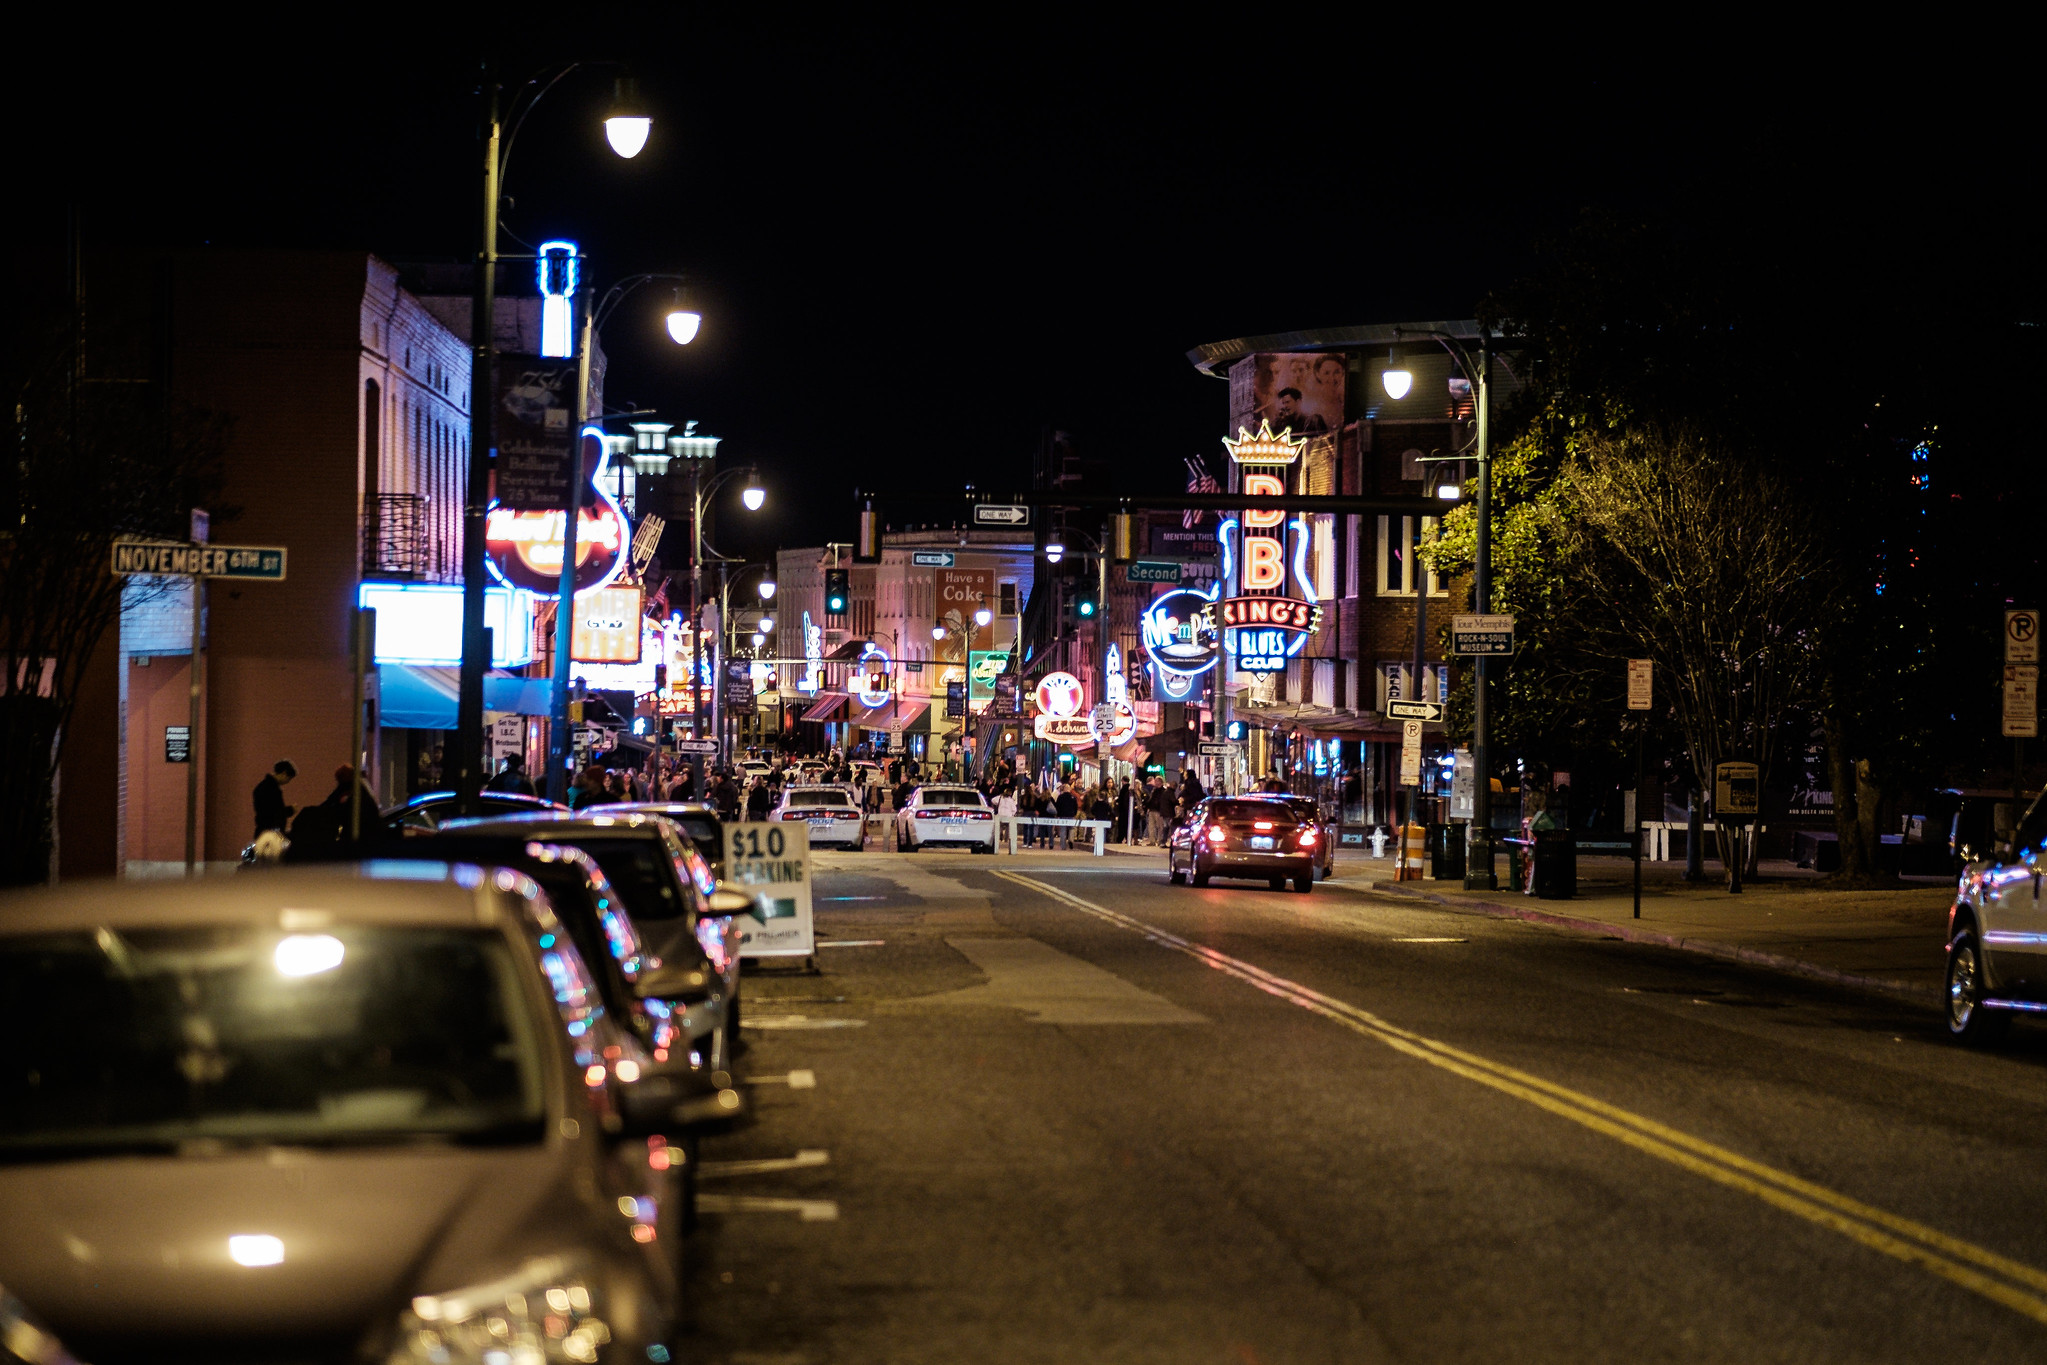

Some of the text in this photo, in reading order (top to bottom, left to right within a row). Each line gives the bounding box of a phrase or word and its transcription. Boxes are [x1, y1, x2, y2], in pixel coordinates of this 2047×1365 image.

[499, 439, 570, 460] Celebrating
[508, 455, 560, 471] Brilliant
[500, 472, 568, 487] Service for
[507, 487, 561, 502] 75 Years
[981, 511, 1013, 519] ONE WAY
[1163, 532, 1215, 541] MENTION THIS
[1192, 542, 1216, 552] FREE
[117, 546, 280, 575] NOVEMBER 6TH ST
[945, 572, 984, 583] Have a
[1131, 564, 1178, 581] Second
[943, 585, 984, 602] Coke
[1224, 601, 1308, 627] KING'S
[1457, 618, 1511, 631] Tour Memphis
[1240, 631, 1285, 656] BLUES
[1458, 634, 1508, 643] ROCK-N-SOUL
[1460, 643, 1493, 652] MUSEUM
[660, 701, 695, 713] CAFE
[1394, 705, 1427, 715] ONE WAY
[497, 719, 519, 727] Get Your
[1056, 719, 1090, 733] Schwa
[1096, 719, 1114, 730] 25
[495, 739, 521, 747] Wristbands
[806, 818, 836, 826] POLICE
[939, 817, 969, 825] POLICE
[732, 827, 786, 859] $10
[733, 860, 803, 885] PARKING
